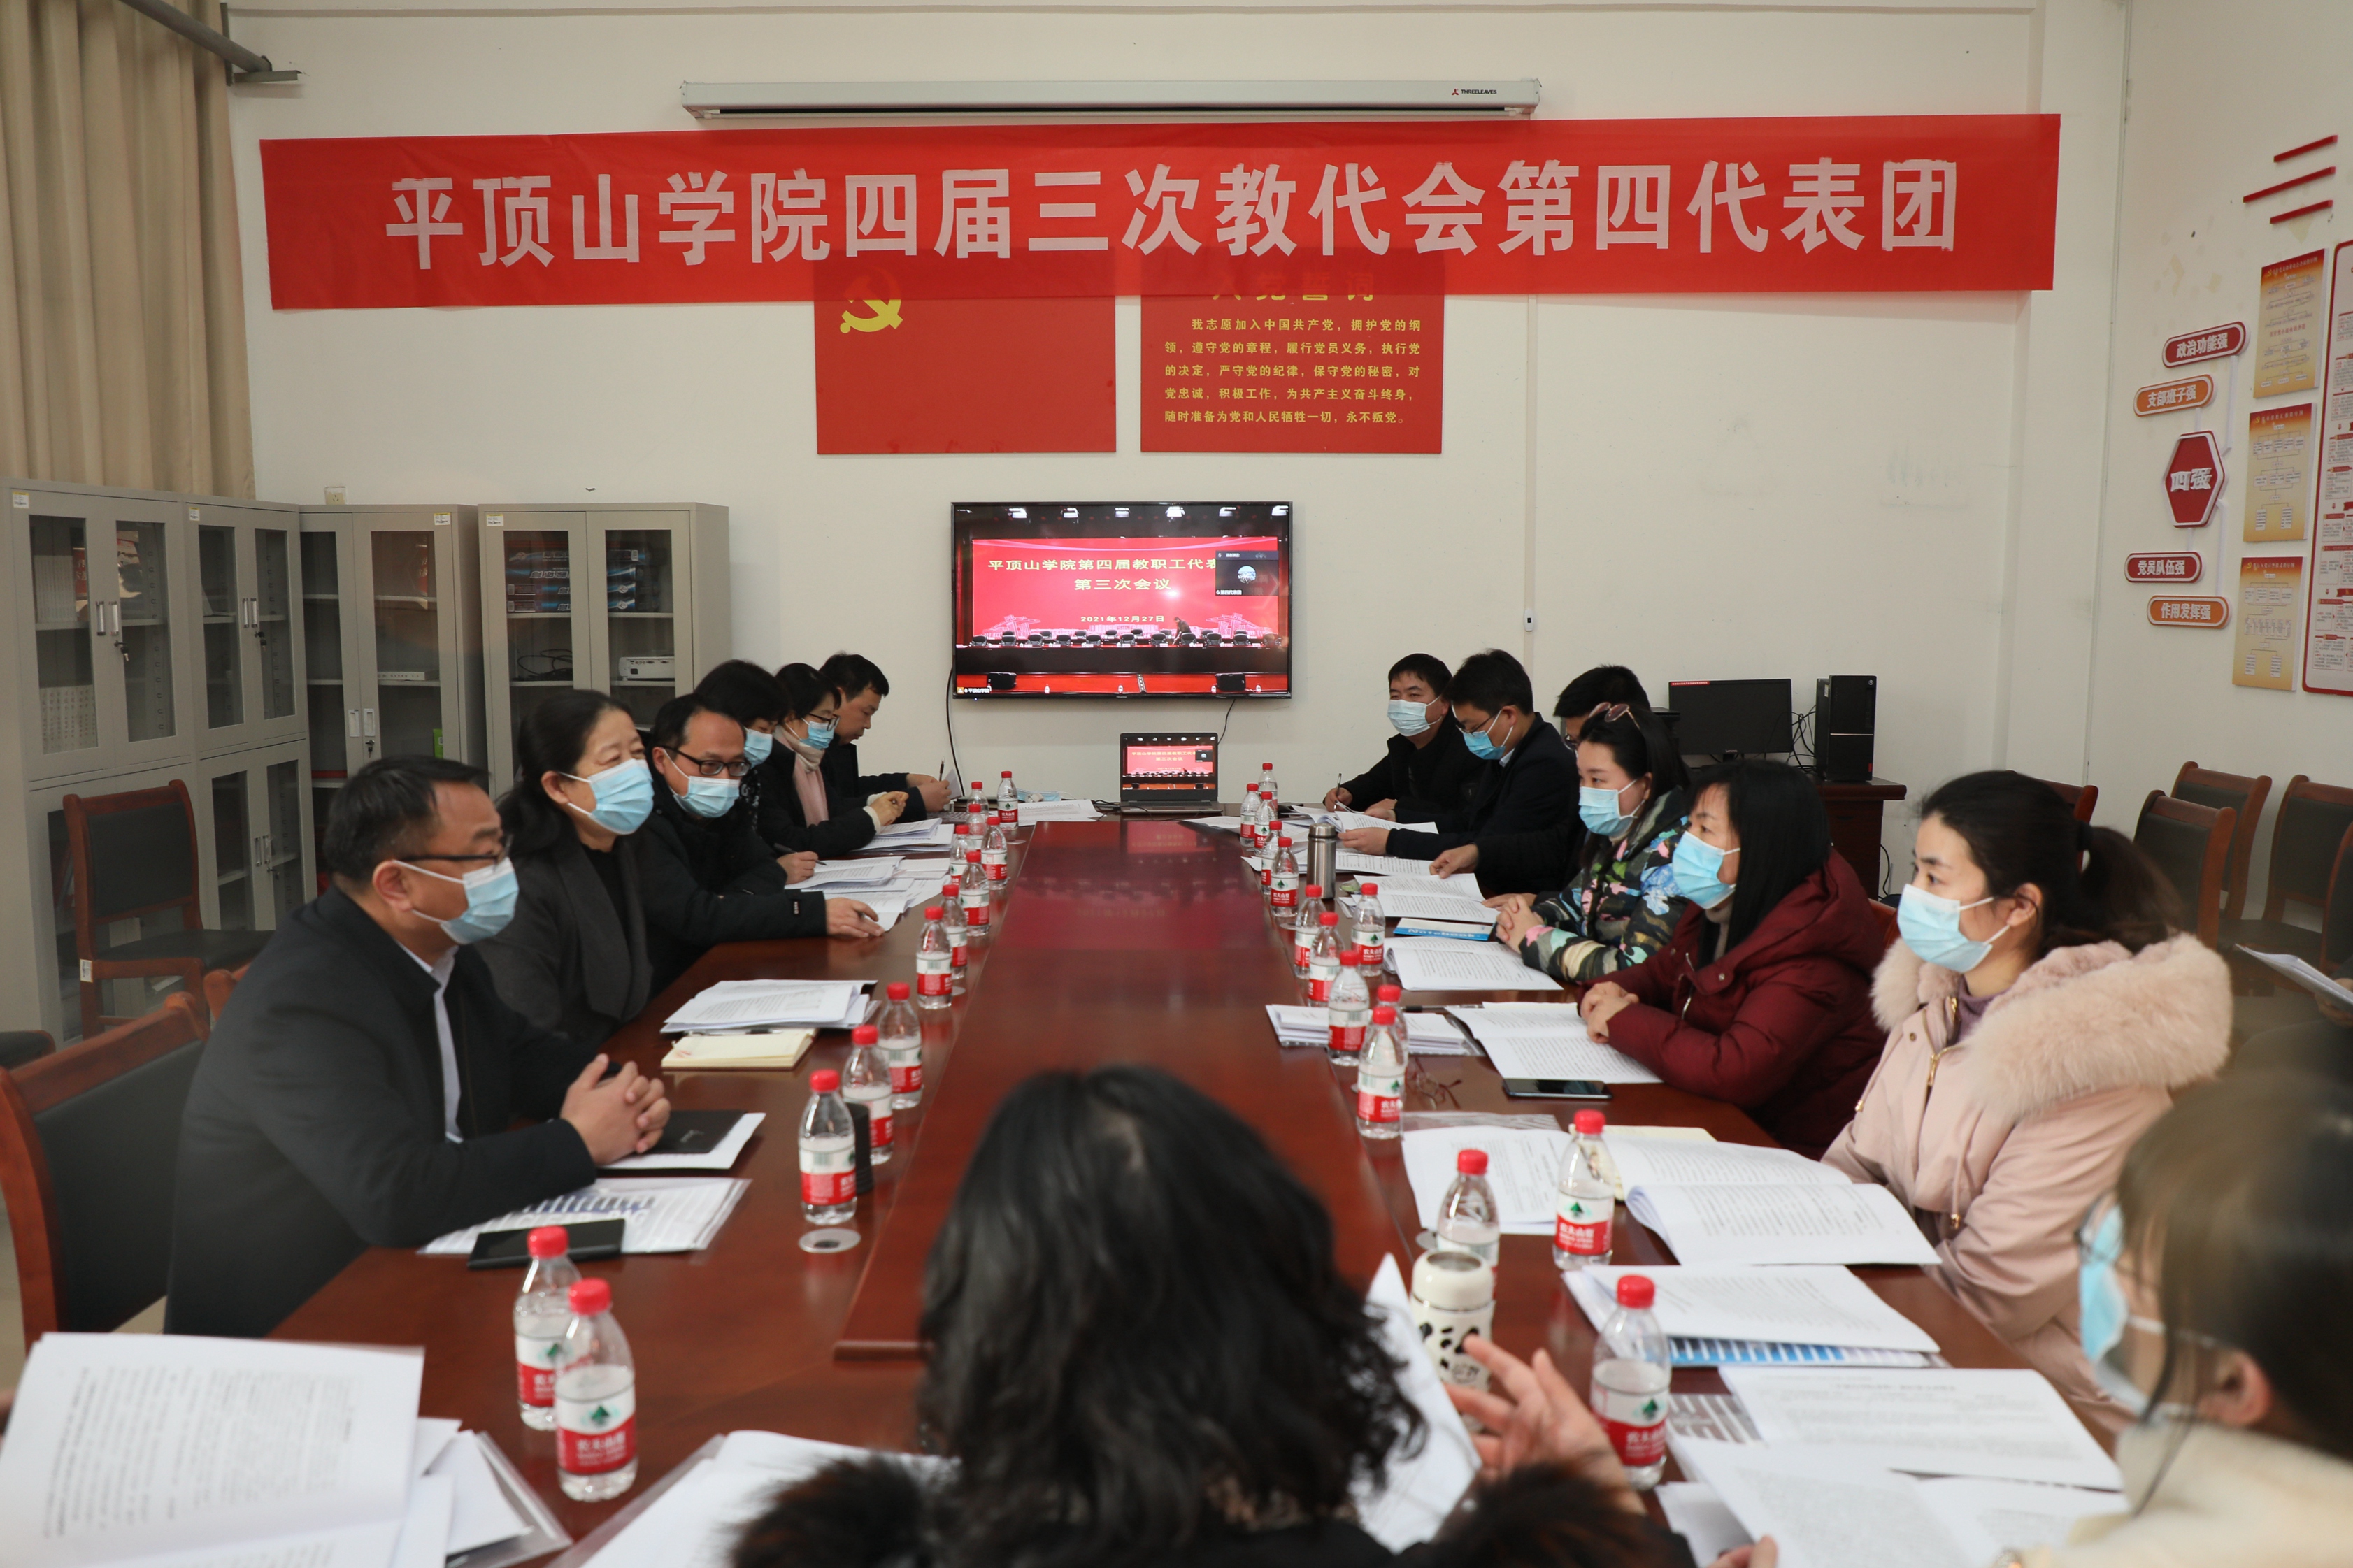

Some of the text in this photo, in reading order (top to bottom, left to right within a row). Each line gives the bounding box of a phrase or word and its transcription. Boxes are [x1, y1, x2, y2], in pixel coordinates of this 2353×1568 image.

[385, 155, 1959, 270] 平顶山学院四届三次教代会第四代表团
[1192, 318, 1422, 332] 我志愿加入中国共产党，拥护党的纲
[1164, 341, 1421, 355] 领，遵守党的章程，履行党员义务，执行党
[2176, 332, 2229, 359] 政治功能强
[1164, 364, 1421, 378] 的决定，严守党的纪律，保守党的秘密，对
[1164, 387, 1414, 401] 党忠诚，积极工作，为共产主义奋斗终身，
[2147, 384, 2197, 408] 支部班子强
[1164, 410, 1403, 424] 随时准备为党和人民牺牲一切，永不叛党。
[2170, 467, 2213, 493] 四强
[2137, 559, 2186, 575] 党员队伍强
[1074, 578, 1172, 591] 第三次会议
[2161, 603, 2212, 620] 作用发挥强
[1408, 928, 1475, 938] Notebook
